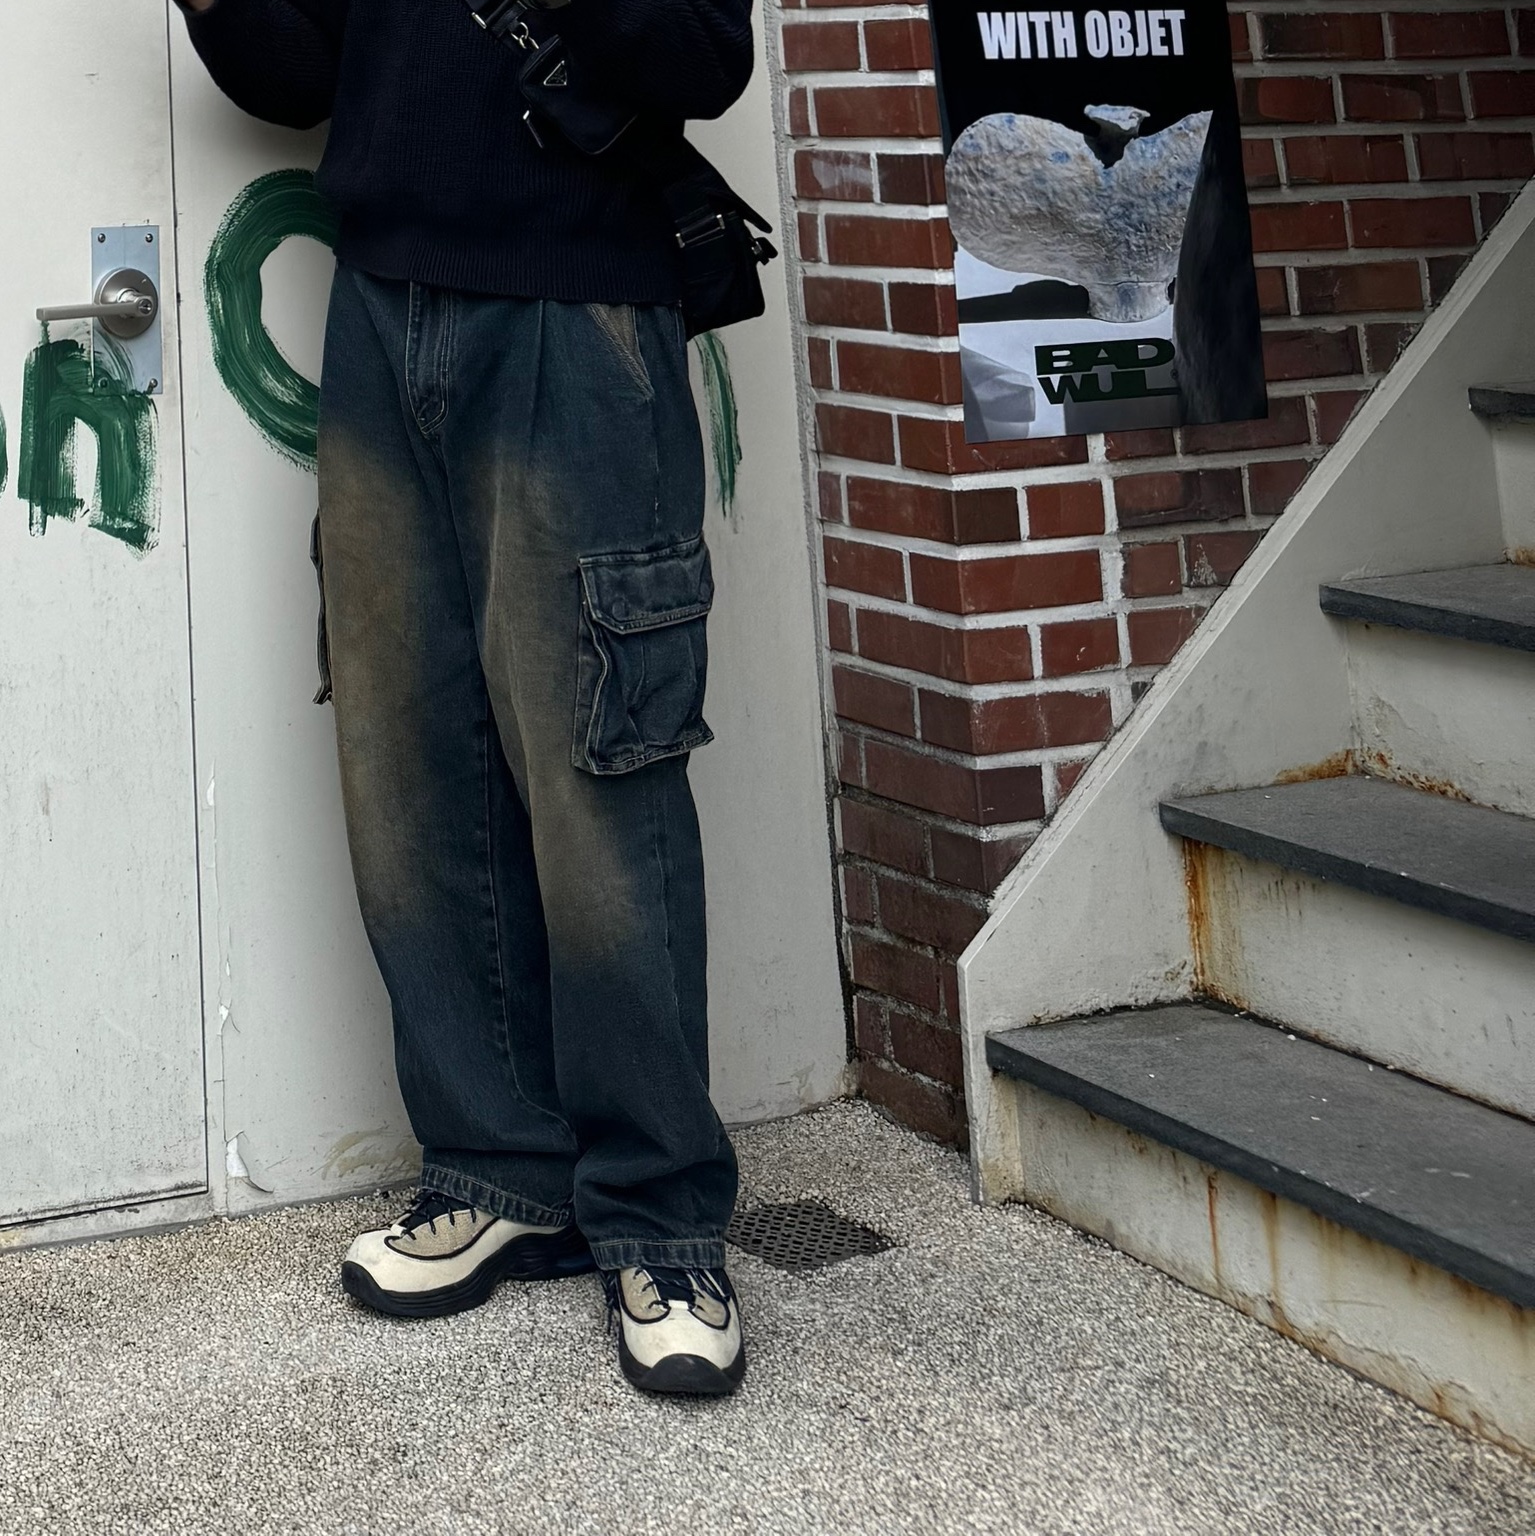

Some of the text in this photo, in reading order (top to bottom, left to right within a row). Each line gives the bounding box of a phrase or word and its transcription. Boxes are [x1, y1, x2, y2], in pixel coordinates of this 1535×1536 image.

[977, 9, 1186, 60] WITH OBJET
[1034, 337, 1176, 376] BAD
